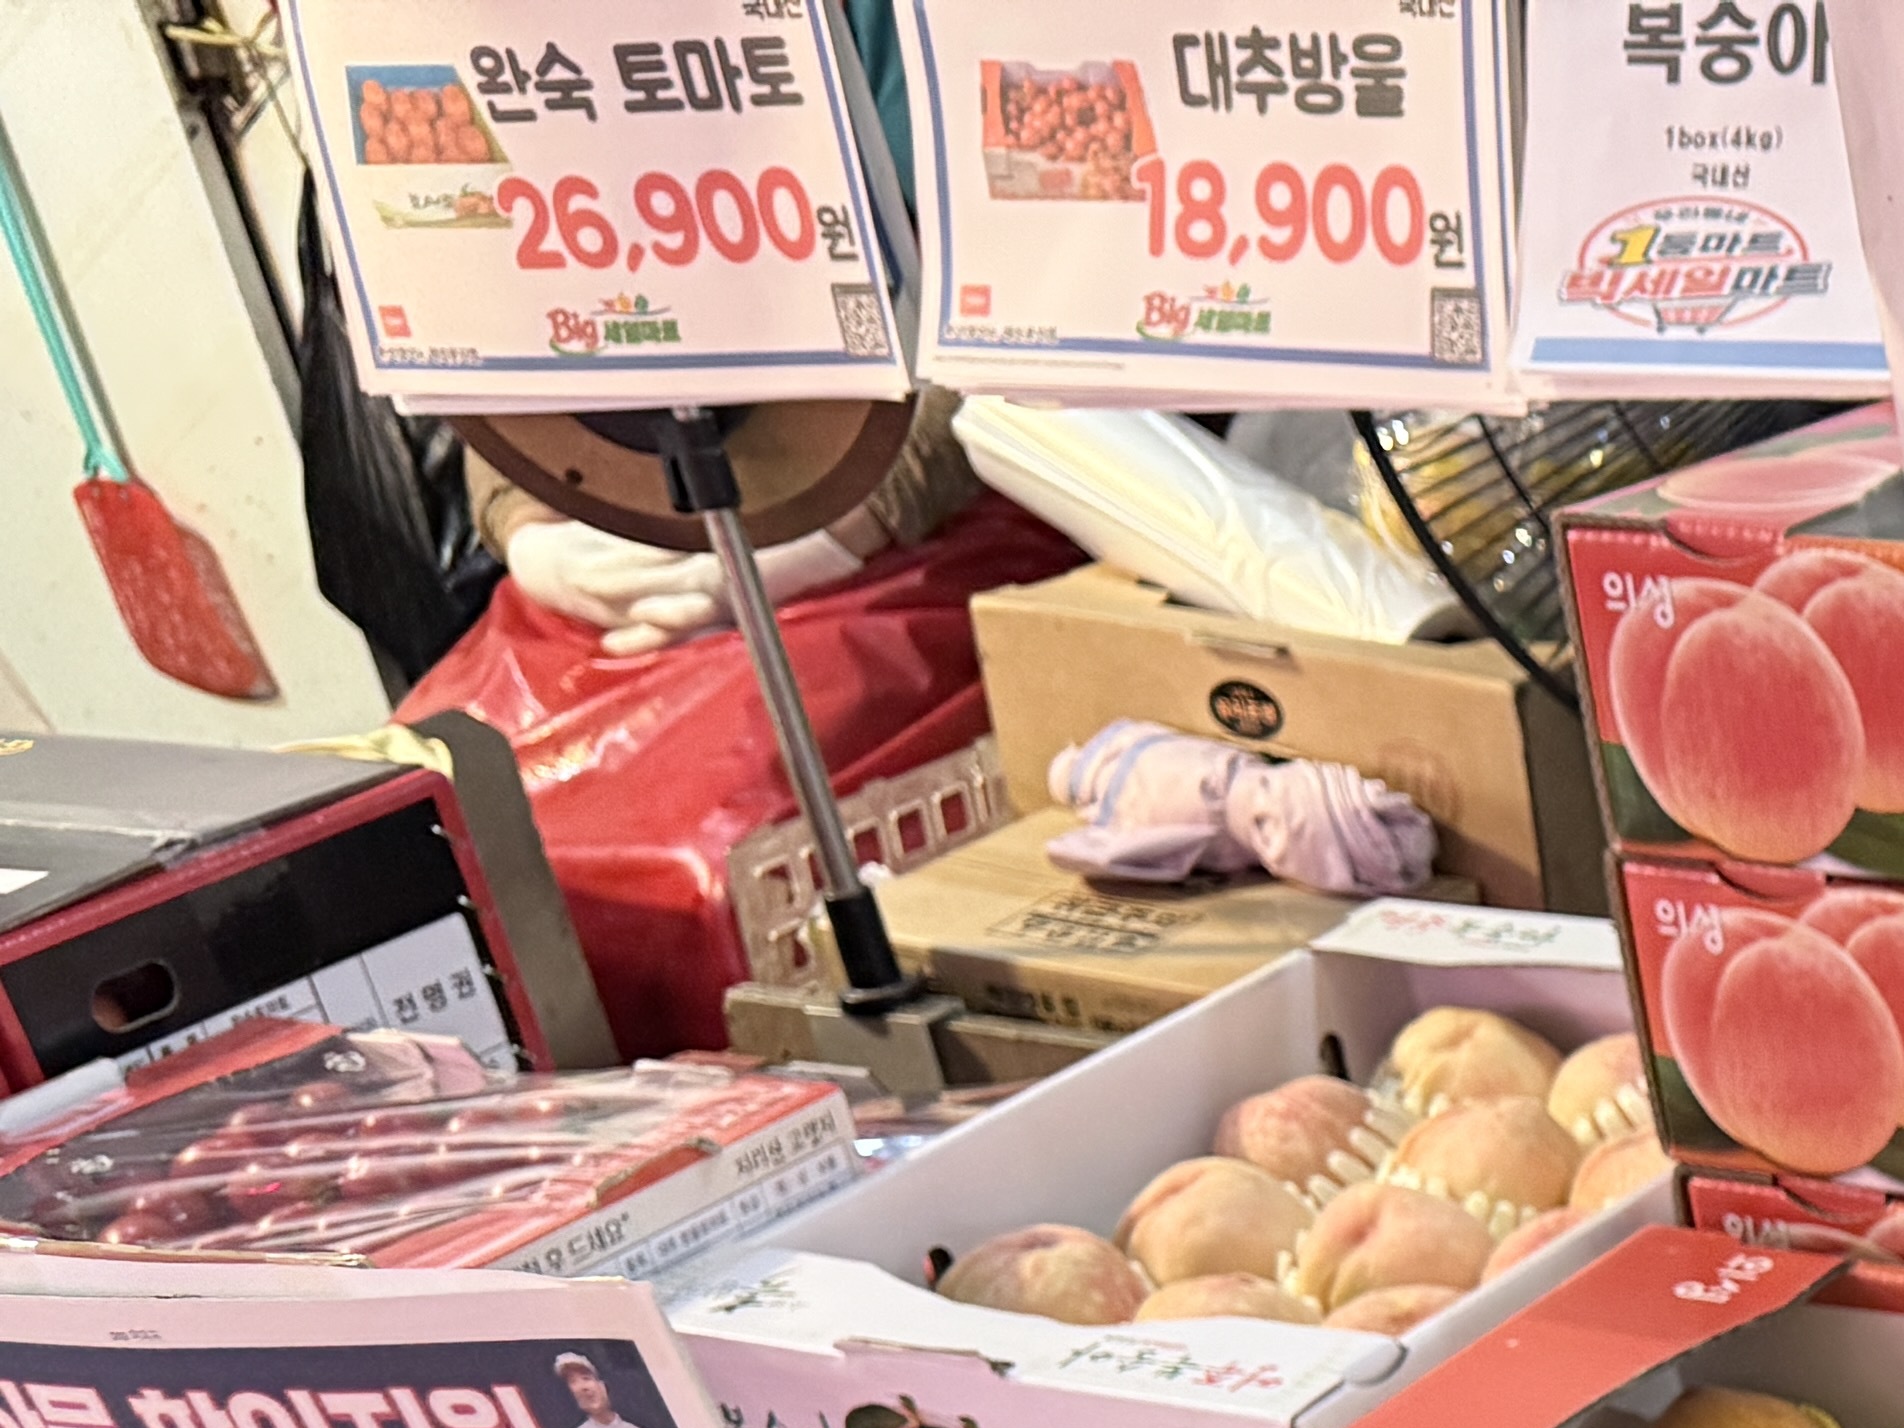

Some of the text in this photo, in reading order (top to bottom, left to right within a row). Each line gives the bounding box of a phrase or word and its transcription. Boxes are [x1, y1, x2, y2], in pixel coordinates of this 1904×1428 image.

[469, 35, 806, 125] 완숙 토마토
[1172, 27, 1407, 118] 대추방울
[1665, 126, 1783, 151] 1box(4kg)
[496, 167, 857, 273] 26,900 원
[1136, 159, 1464, 270] 18,900 원
